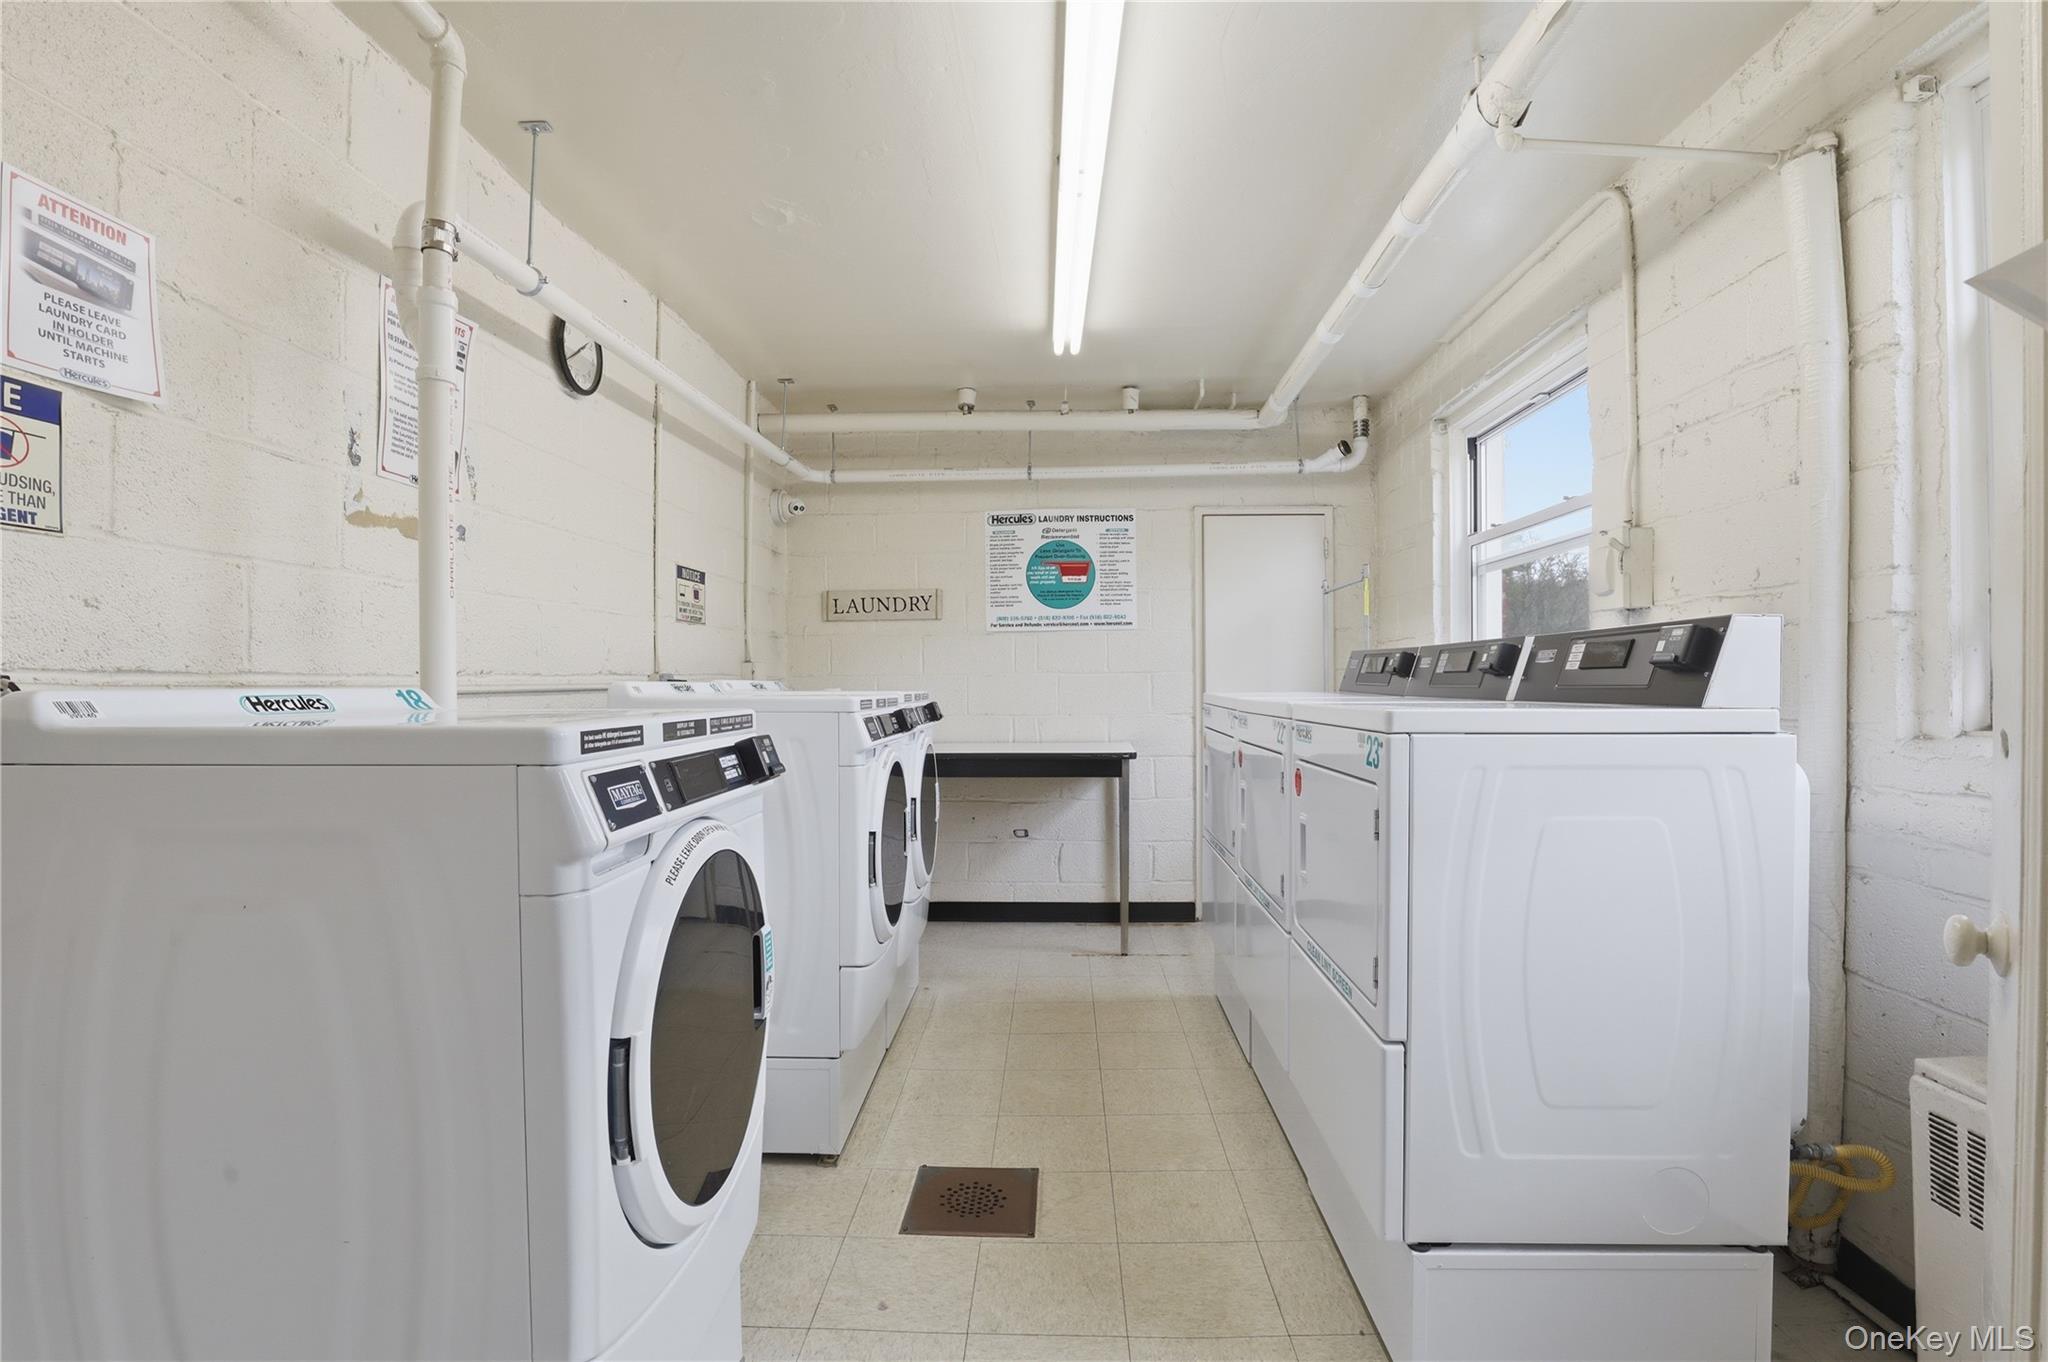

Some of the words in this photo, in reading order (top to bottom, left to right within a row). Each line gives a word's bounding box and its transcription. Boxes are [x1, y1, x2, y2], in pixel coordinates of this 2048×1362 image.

[38, 193, 127, 246] ATTENTION
[44, 292, 85, 315] PLEASE
[88, 309, 121, 327] LEAVE
[39, 303, 93, 329] LAUNDRY
[96, 324, 127, 340] CARD
[53, 320, 65, 331] IN
[68, 326, 114, 348] HOLDER
[38, 328, 72, 347] UNTIL
[76, 341, 128, 363] MACHINE
[63, 349, 106, 368] STARTS
[63, 367, 108, 388] Hercules
[8, 490, 46, 509] THAN
[991, 514, 1033, 525] Hercules
[1038, 515, 1074, 523] LAUNDRY
[1077, 514, 1134, 523] INSTRUCTIONS
[832, 595, 933, 614] LAUNDRY
[245, 694, 330, 712] Hercules
[395, 689, 433, 711] 18
[1366, 735, 1380, 769] 23
[611, 783, 643, 801] MAYTAG
[664, 856, 685, 887] PLEASE
[680, 839, 697, 861] LEAVE
